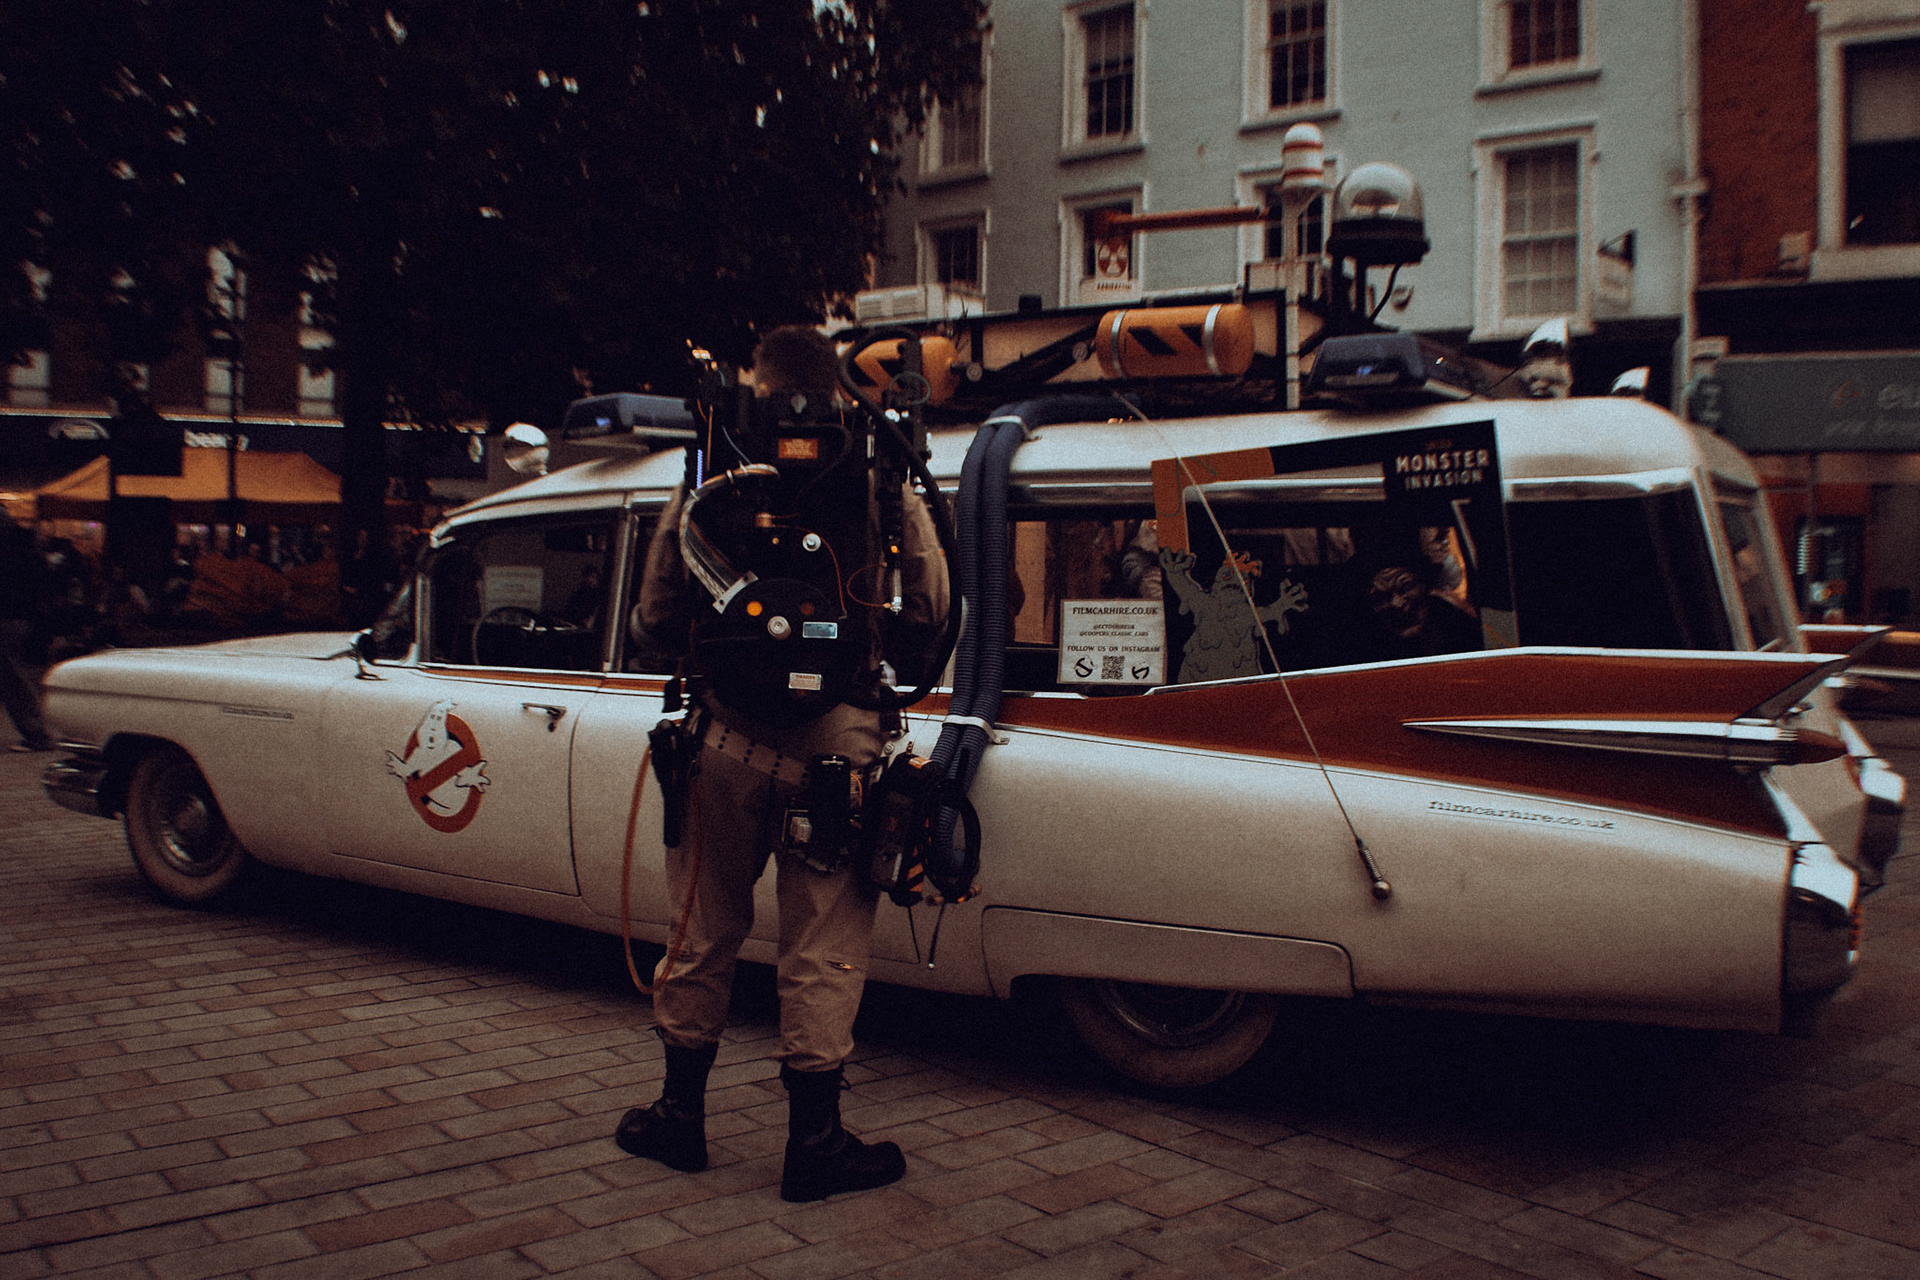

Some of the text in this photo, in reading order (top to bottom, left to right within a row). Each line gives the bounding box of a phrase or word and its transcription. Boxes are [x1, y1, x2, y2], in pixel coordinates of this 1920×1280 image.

[1396, 449, 1489, 473] MONSTER
[1404, 469, 1483, 490] INVASION
[1072, 607, 1158, 615] FILMCARHIRE.CO.UK
[1428, 800, 1615, 829] filmcarhire.co.uk
